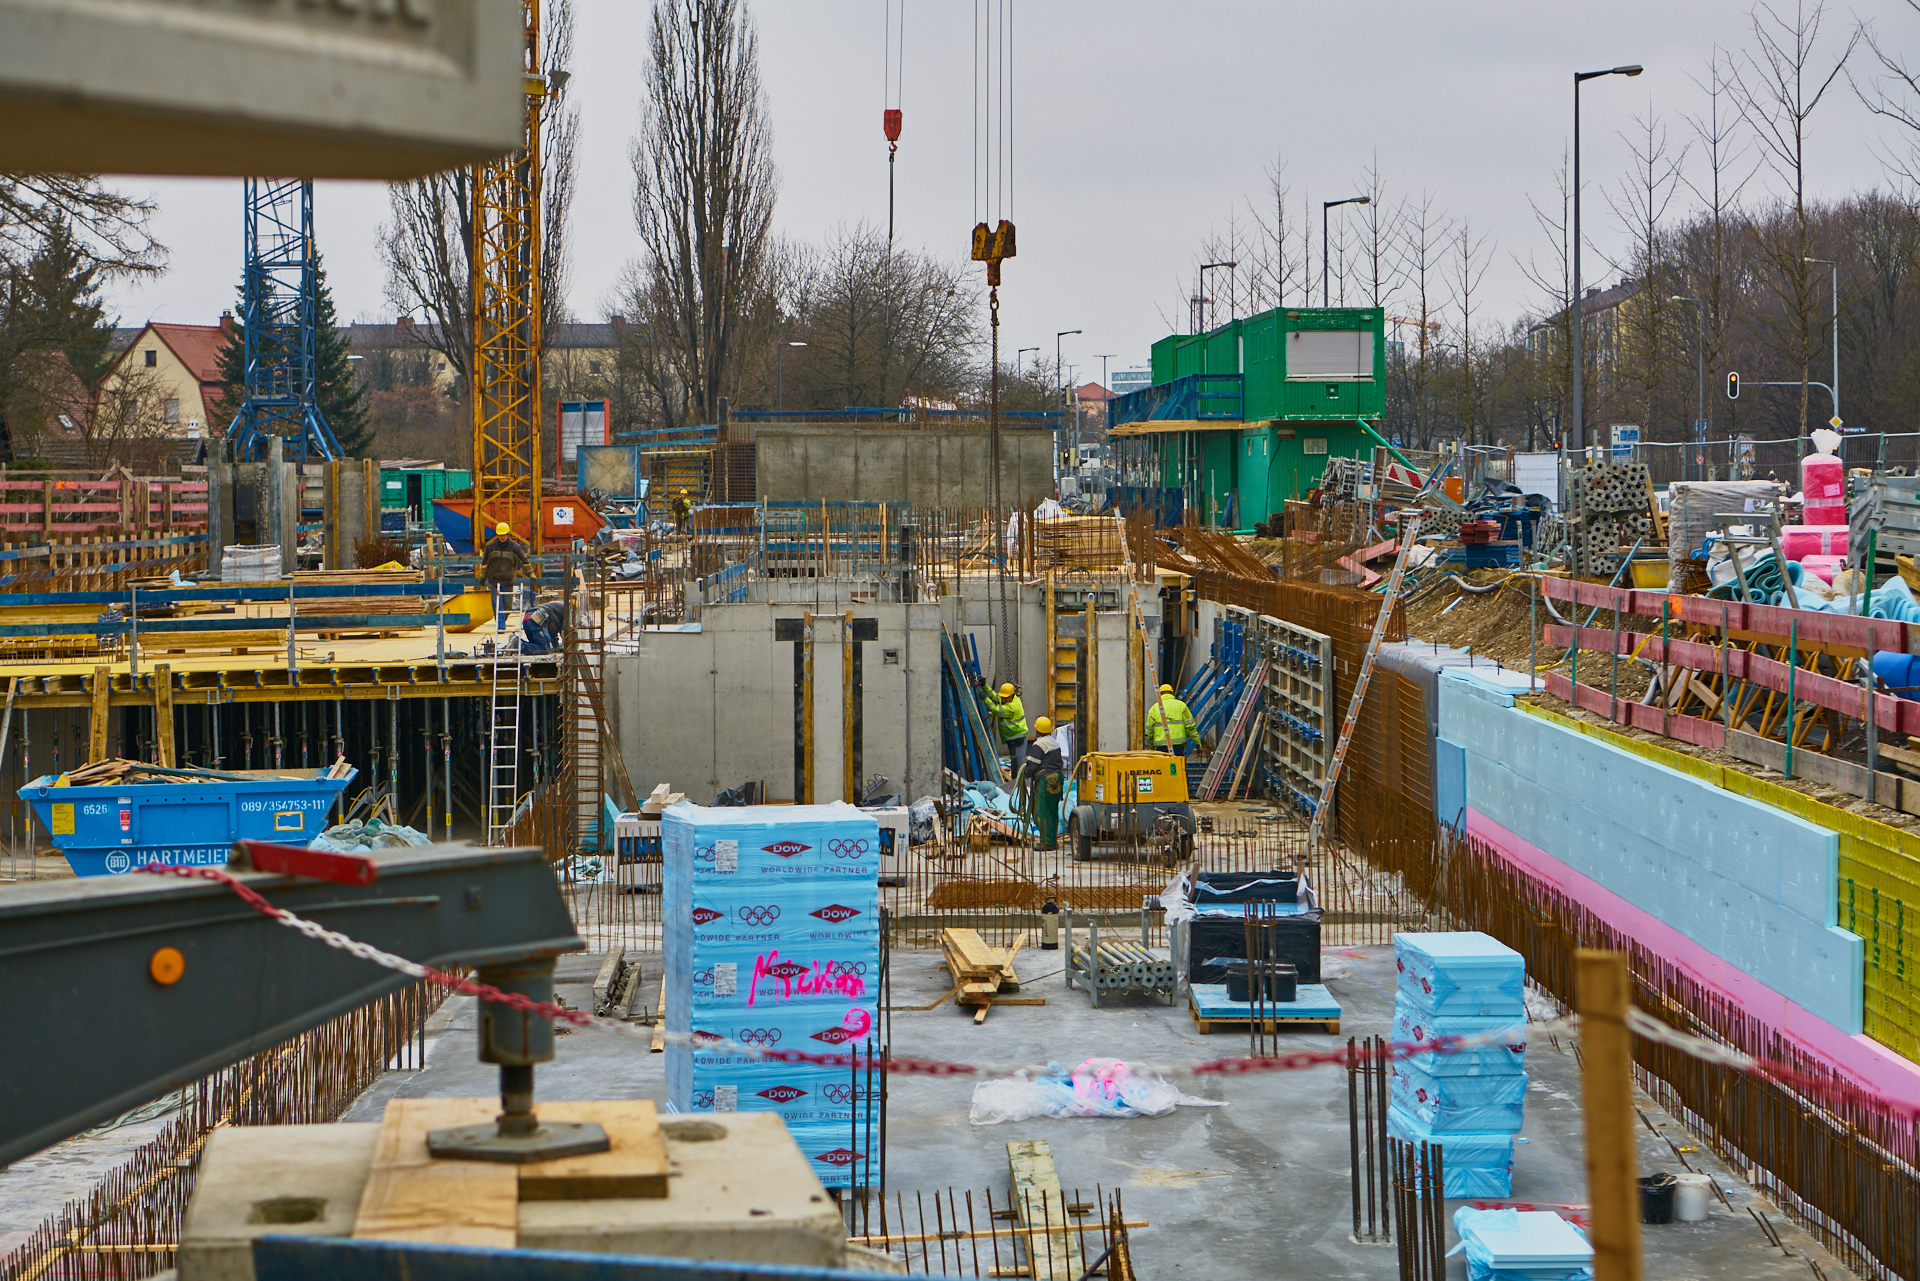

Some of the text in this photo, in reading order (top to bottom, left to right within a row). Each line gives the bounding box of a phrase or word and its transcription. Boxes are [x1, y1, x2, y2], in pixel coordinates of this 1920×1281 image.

[84, 804, 108, 815] 6526
[241, 799, 325, 812] 089/354753-111
[773, 844, 803, 853] DOW
[110, 856, 126, 868] BTU
[693, 912, 715, 921] OW
[821, 909, 852, 919] DOW
[771, 966, 801, 975] DOW
[768, 1089, 799, 1099] DOW
